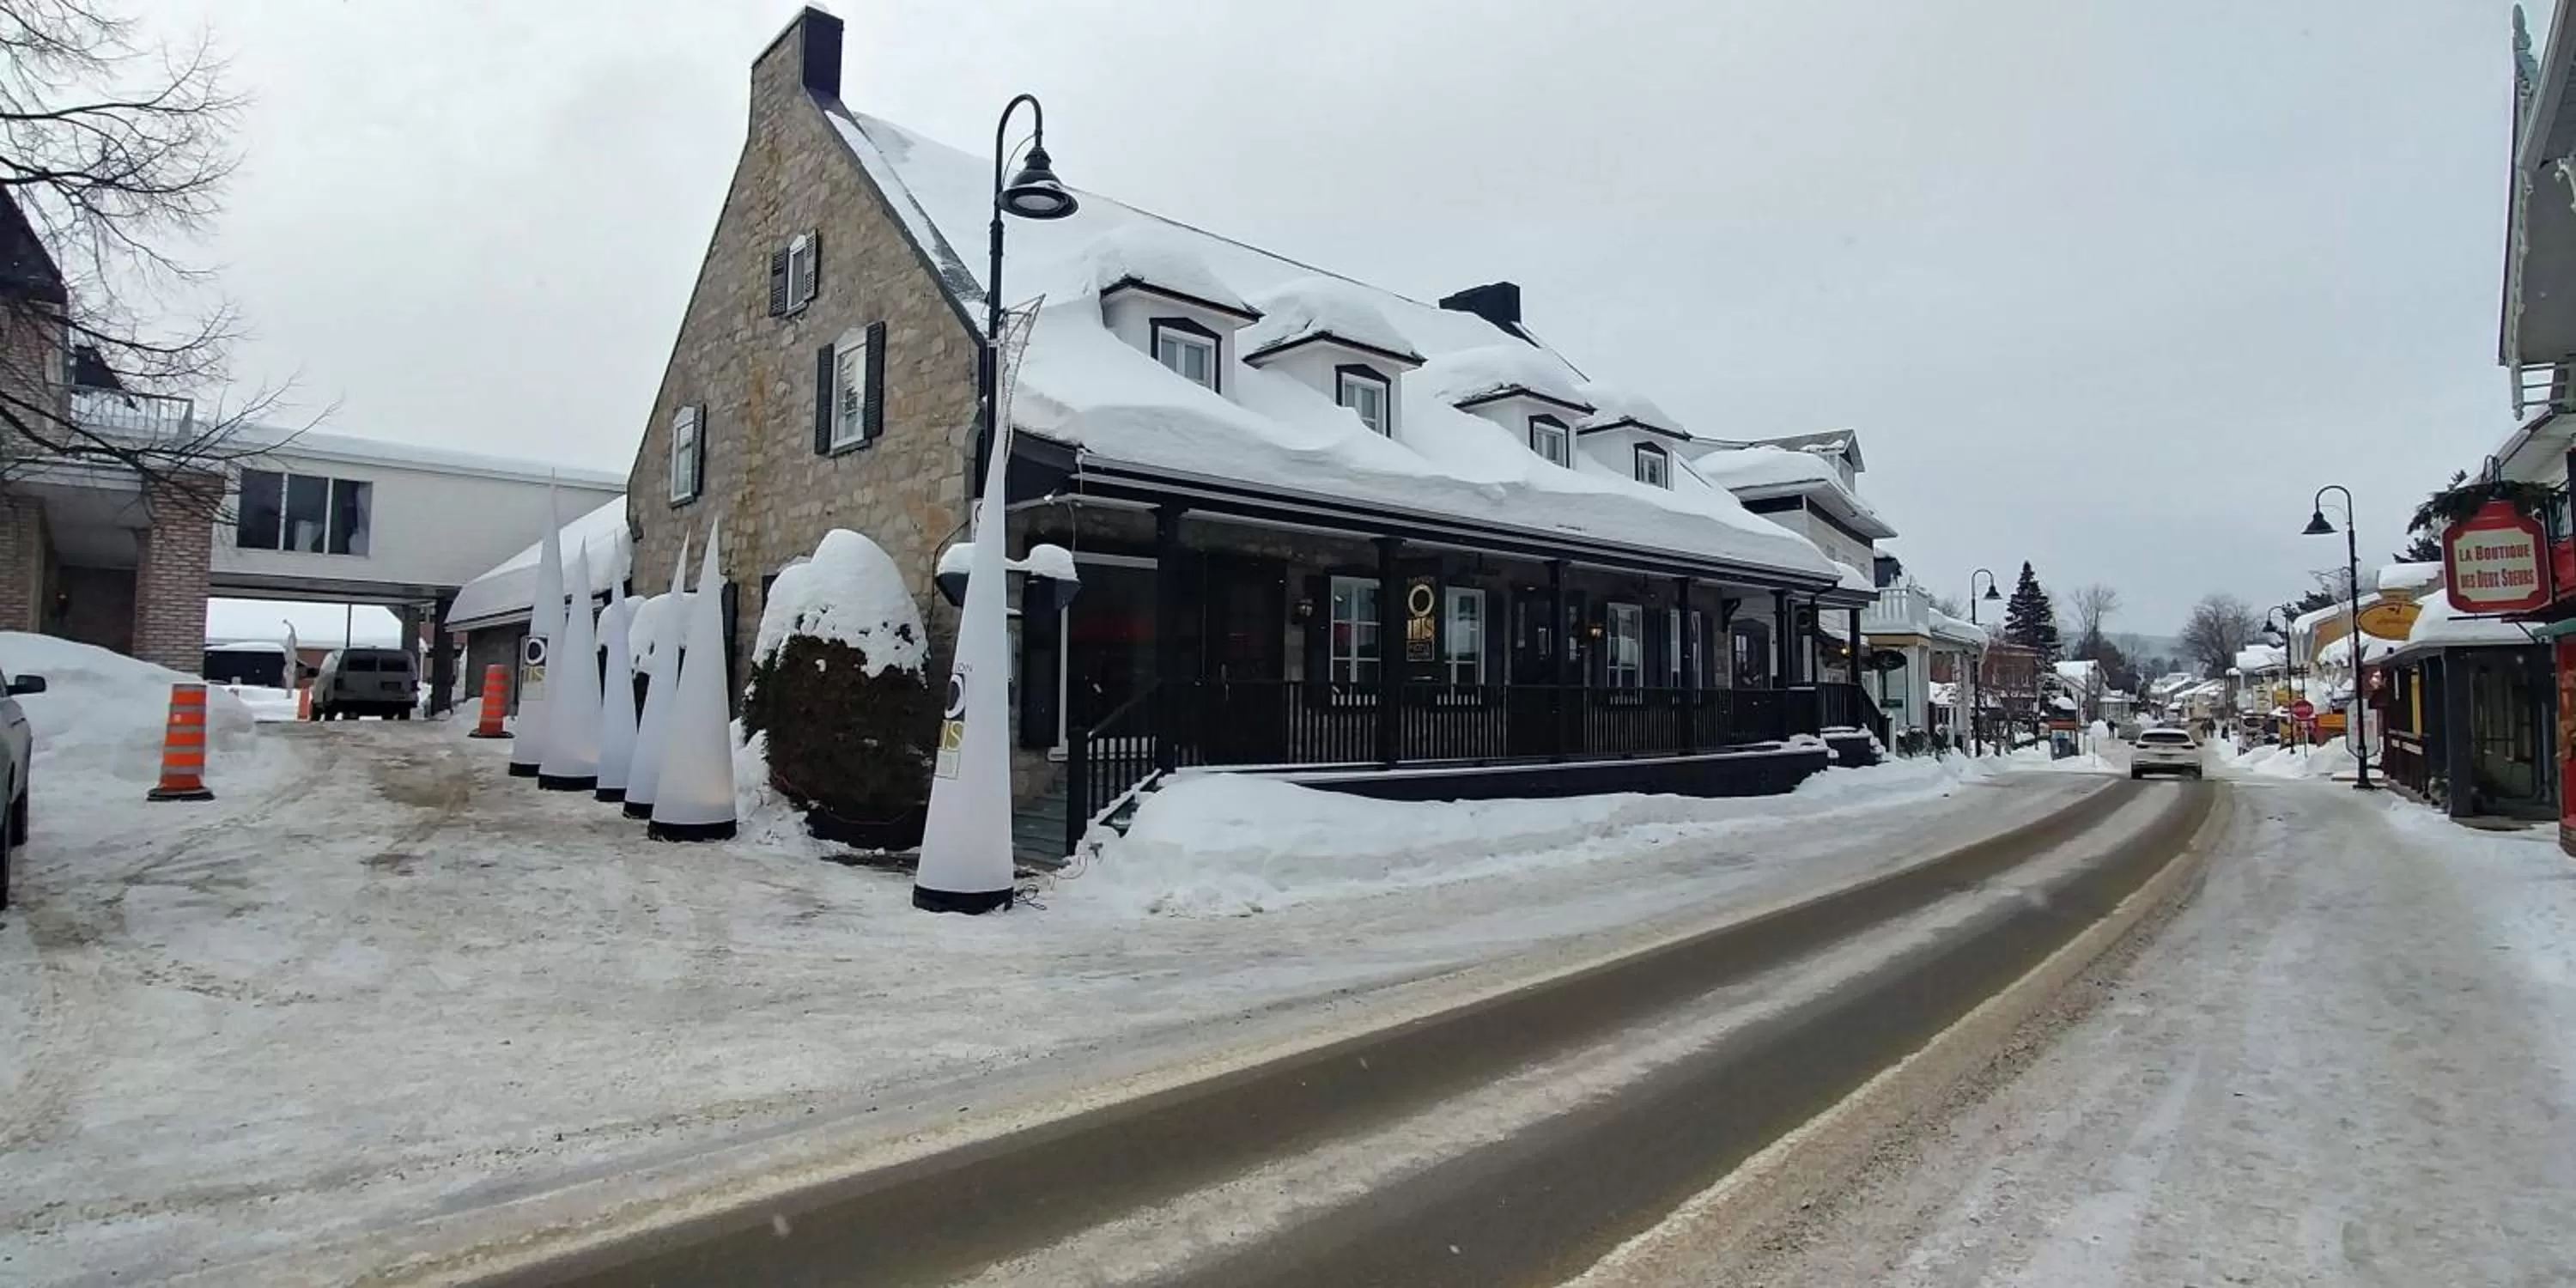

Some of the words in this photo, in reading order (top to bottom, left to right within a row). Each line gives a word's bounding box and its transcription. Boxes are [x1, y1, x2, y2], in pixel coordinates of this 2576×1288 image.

[2458, 548, 2473, 562] LA
[2475, 544, 2531, 561] BOUTIQUE
[2460, 574, 2475, 588] DES
